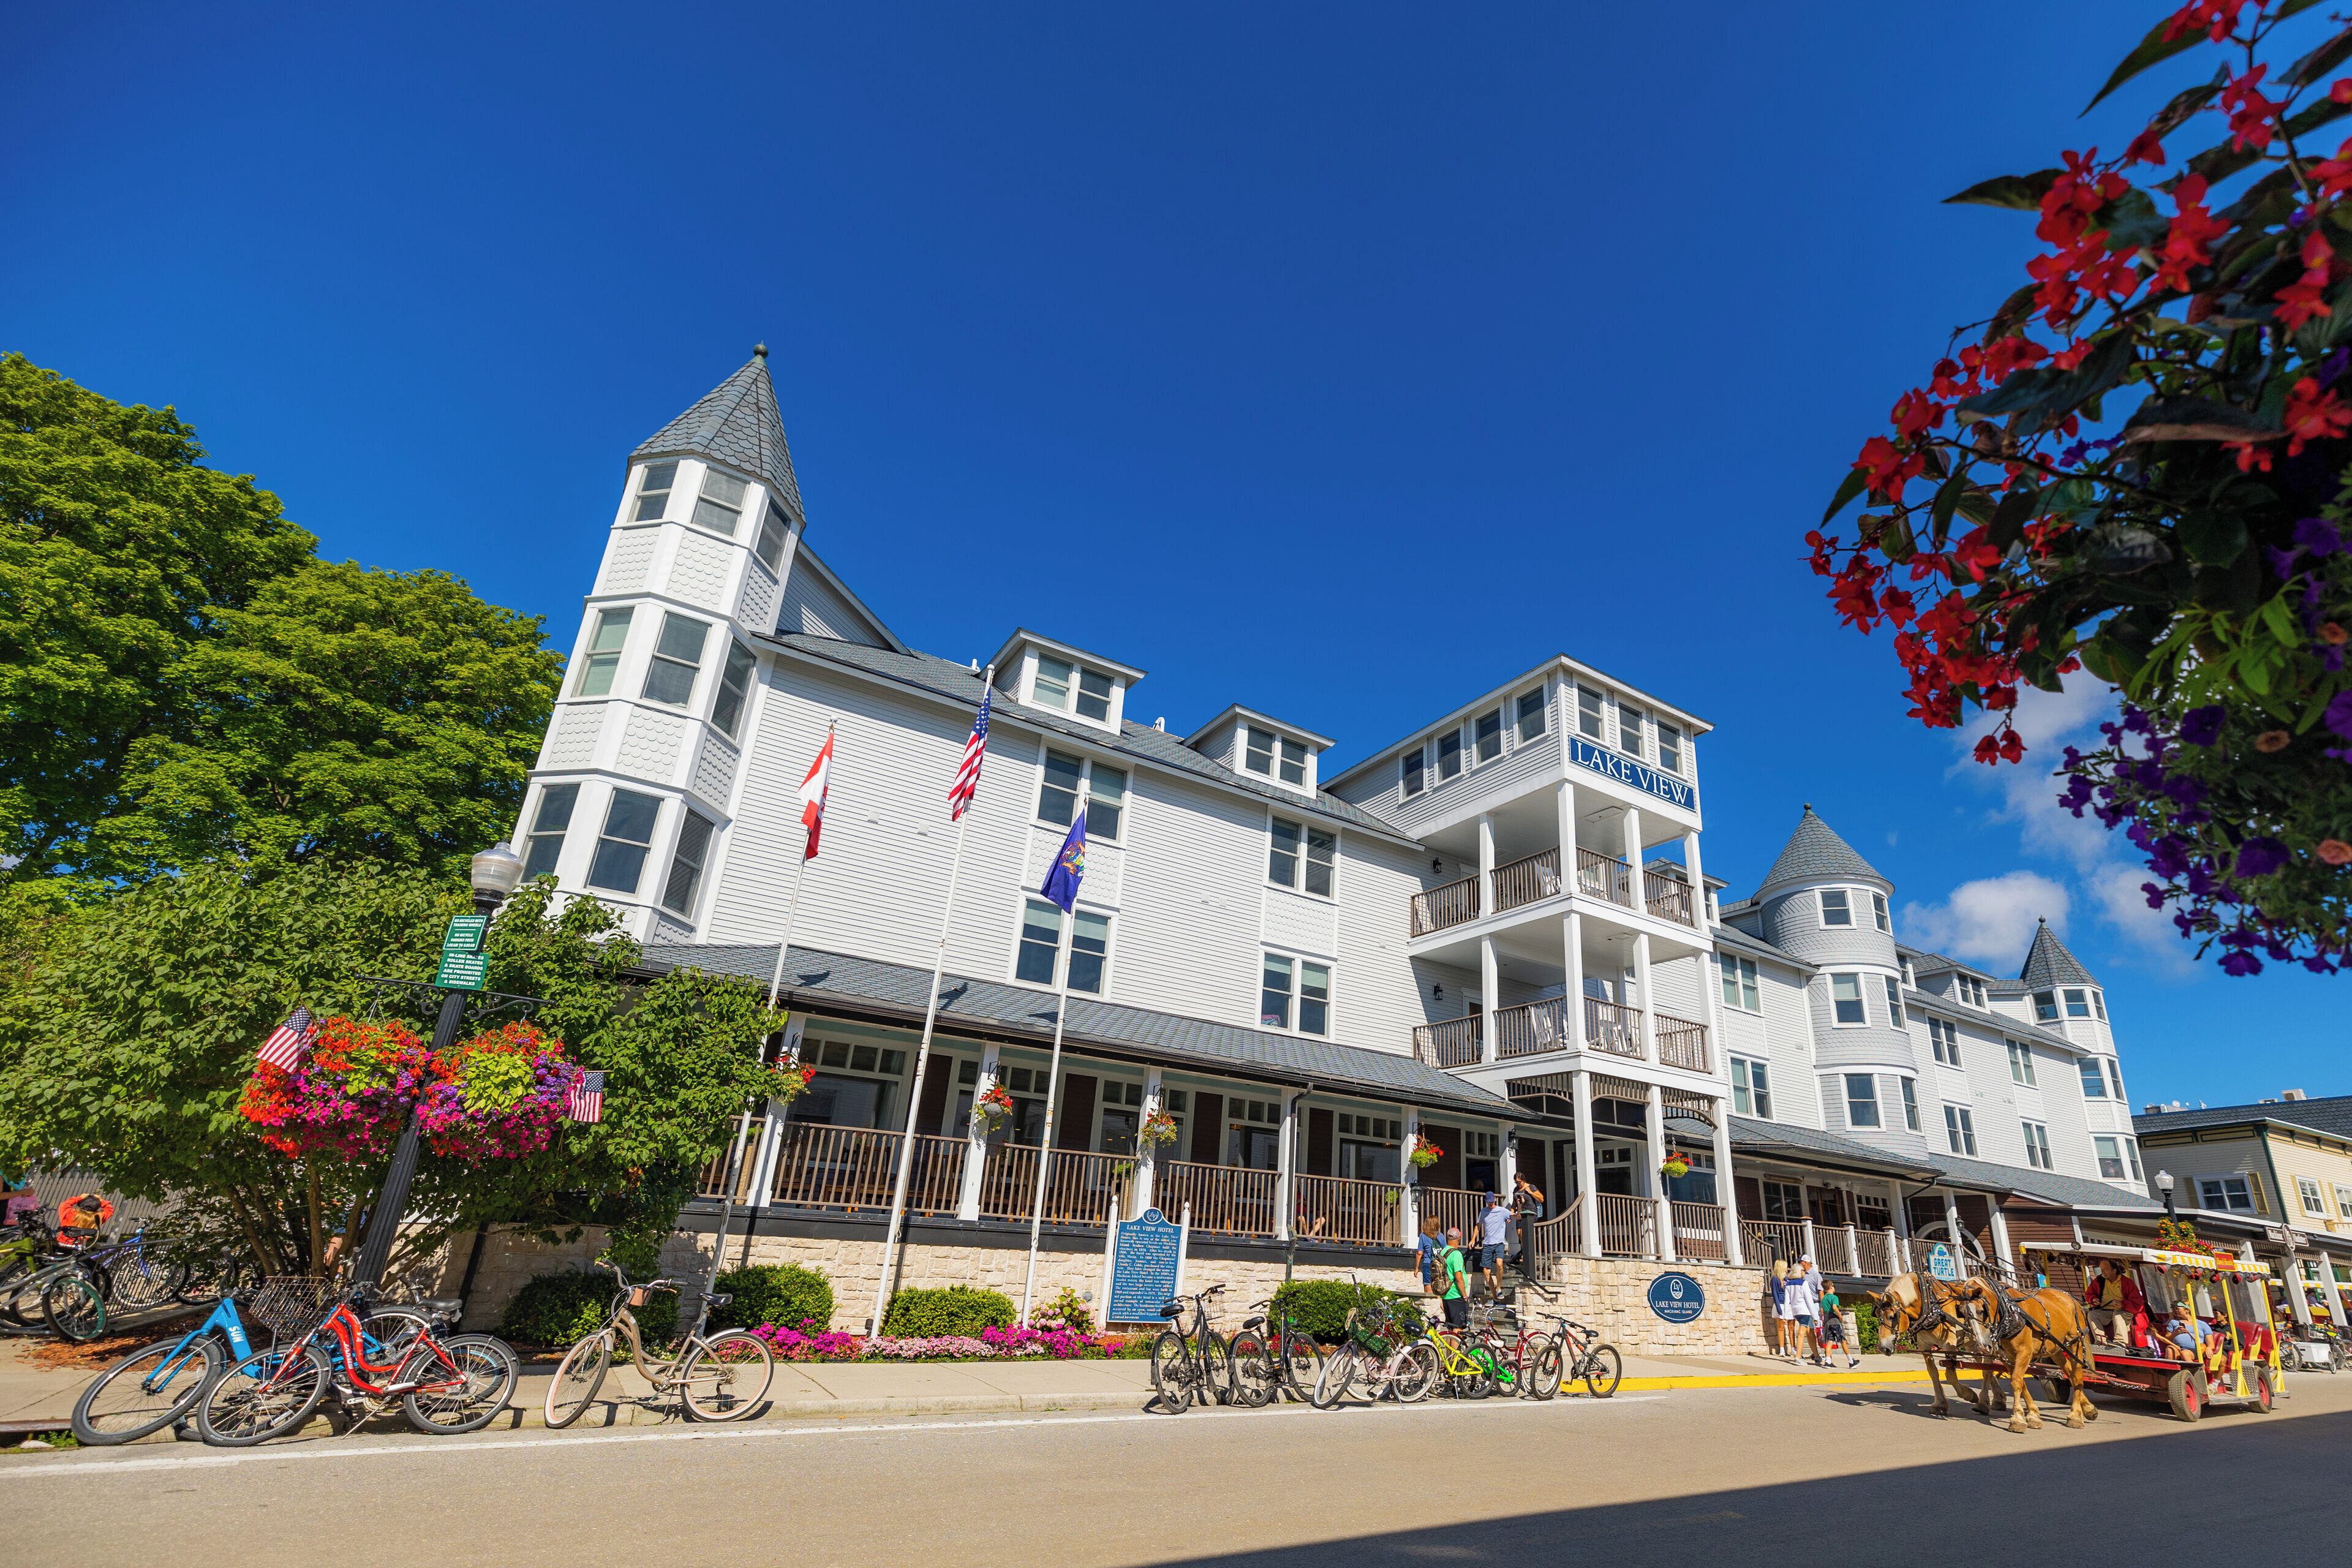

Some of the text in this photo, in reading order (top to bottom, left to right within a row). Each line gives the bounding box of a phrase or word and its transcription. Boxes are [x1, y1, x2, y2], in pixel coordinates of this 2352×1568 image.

[1576, 741, 1688, 804] LAKE VIEW
[1934, 1257, 1951, 1267] GREAT
[1933, 1267, 1954, 1276] TURTLE
[228, 1325, 244, 1343] SUN
